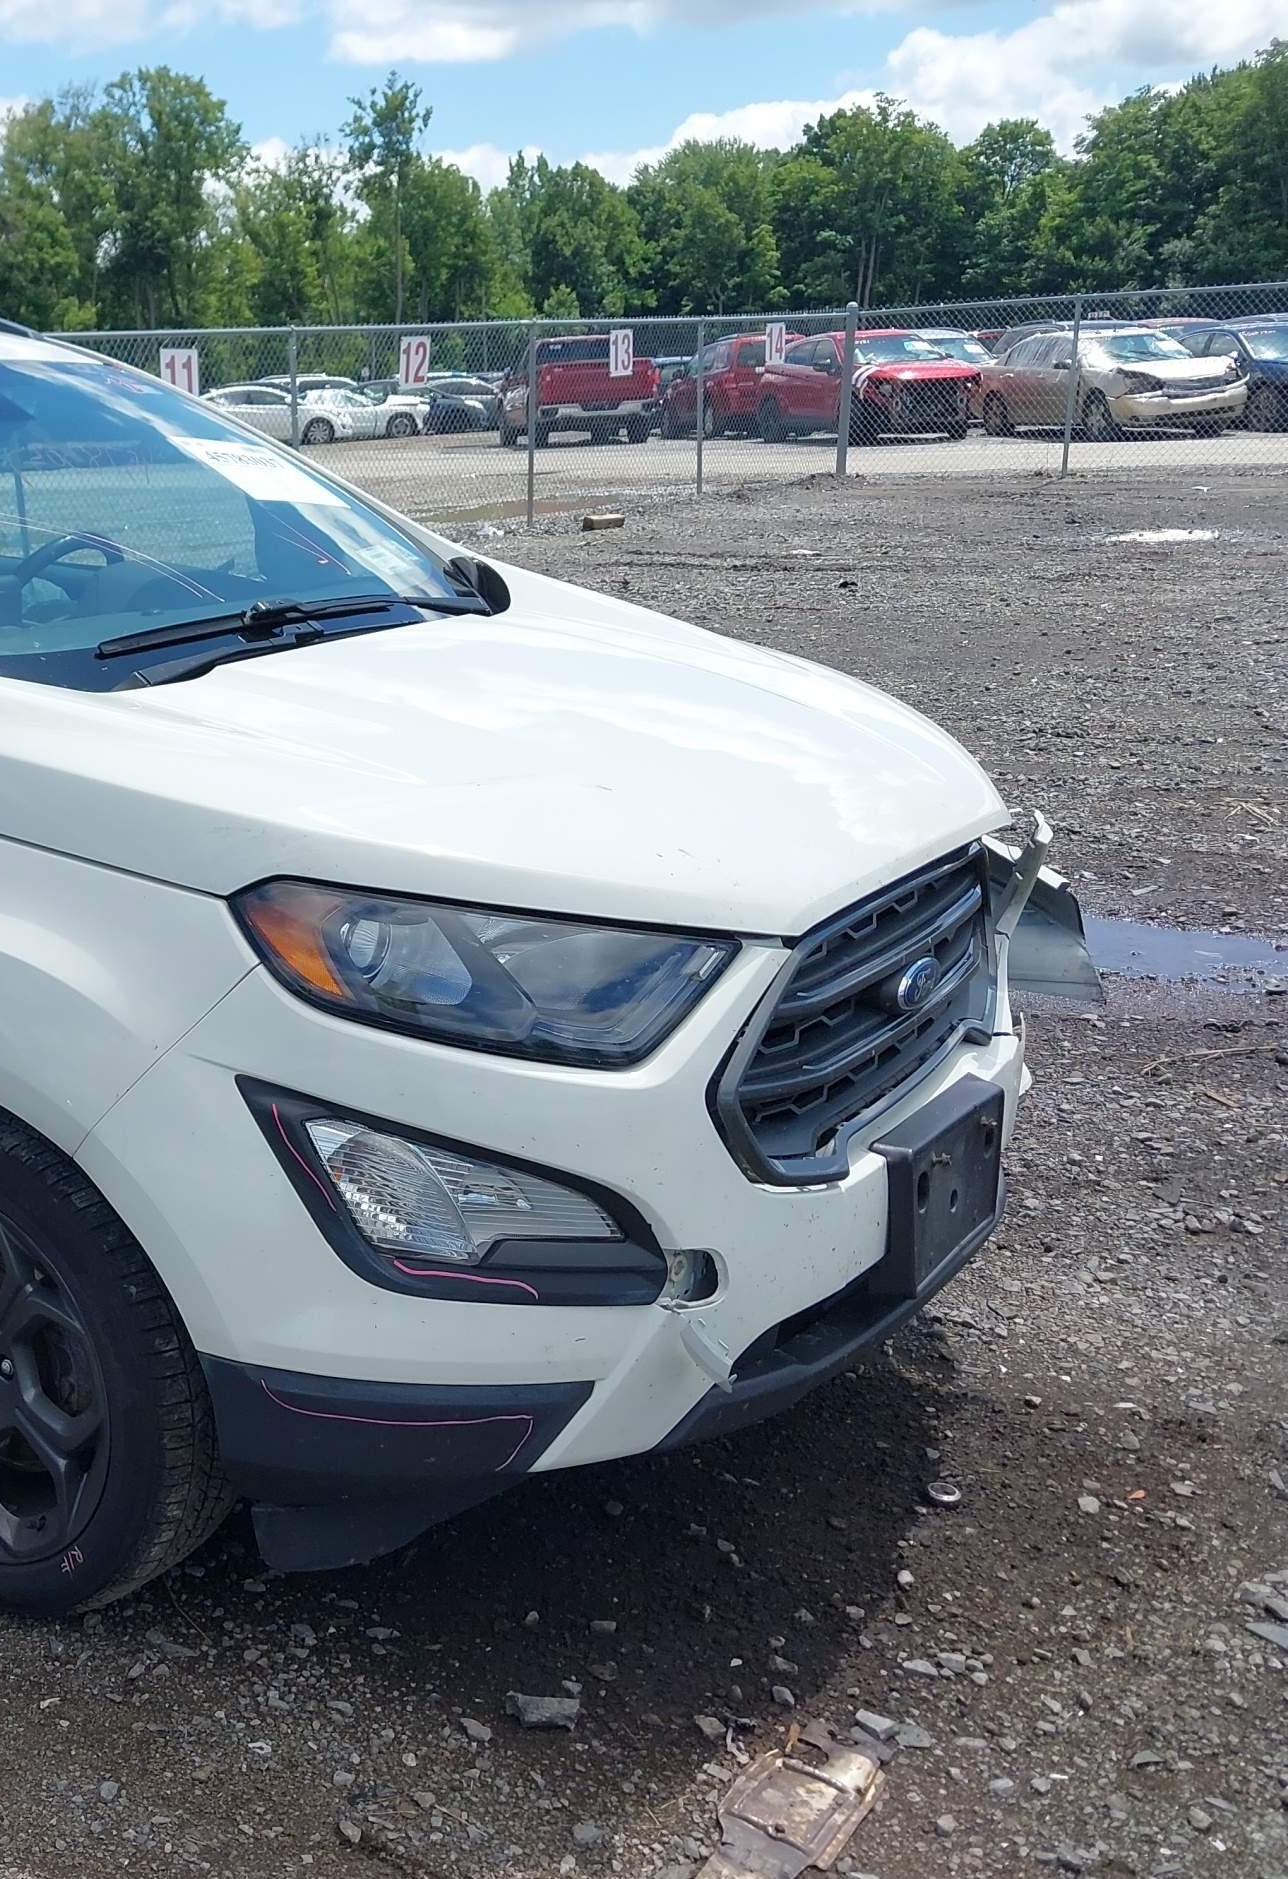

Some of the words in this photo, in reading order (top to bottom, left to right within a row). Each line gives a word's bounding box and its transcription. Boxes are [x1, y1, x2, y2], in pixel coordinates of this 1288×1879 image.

[612, 334, 631, 371] 13
[767, 326, 783, 360] 14
[165, 354, 193, 394] 11
[402, 341, 427, 384] 12
